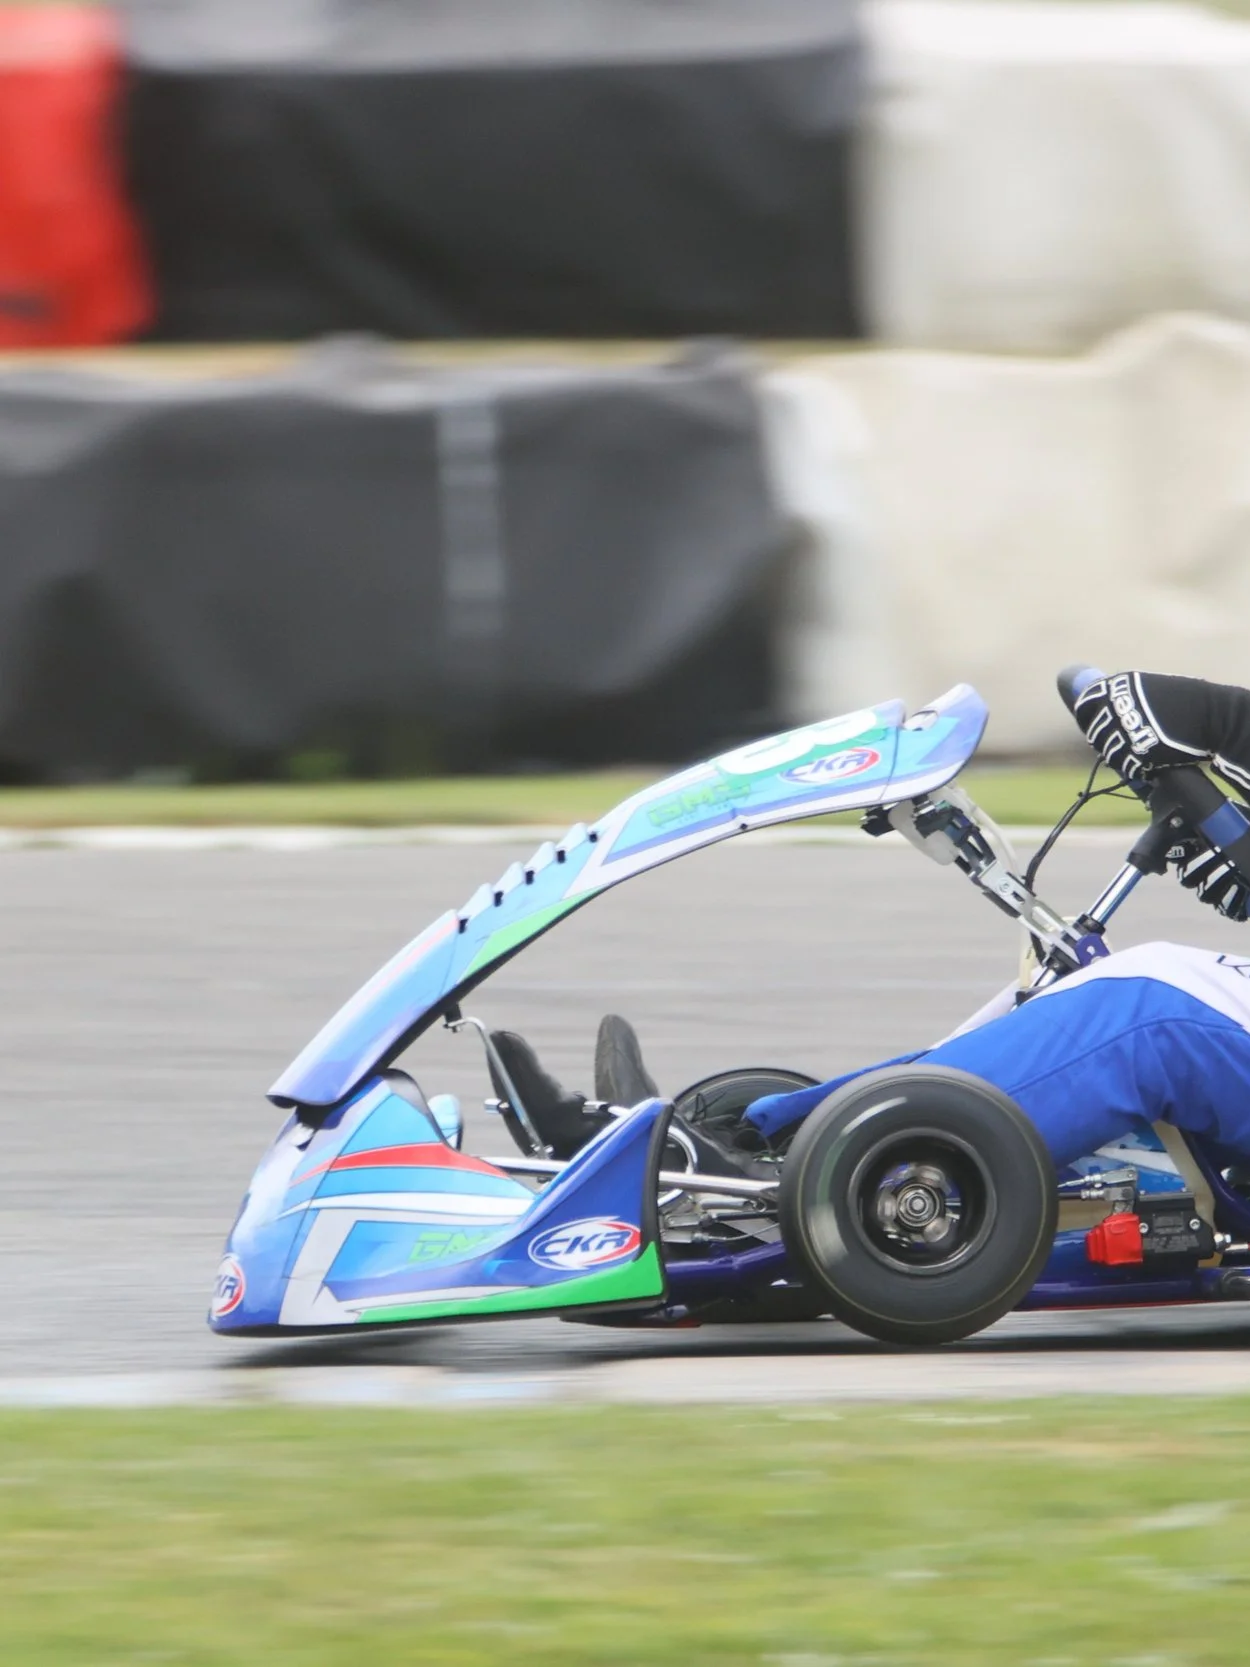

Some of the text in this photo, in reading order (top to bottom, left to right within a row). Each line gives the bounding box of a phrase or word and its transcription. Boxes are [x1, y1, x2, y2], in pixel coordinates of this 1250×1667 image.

[1107, 673, 1159, 755] freem
[783, 751, 870, 778] CKR
[535, 1230, 632, 1257] CKR
